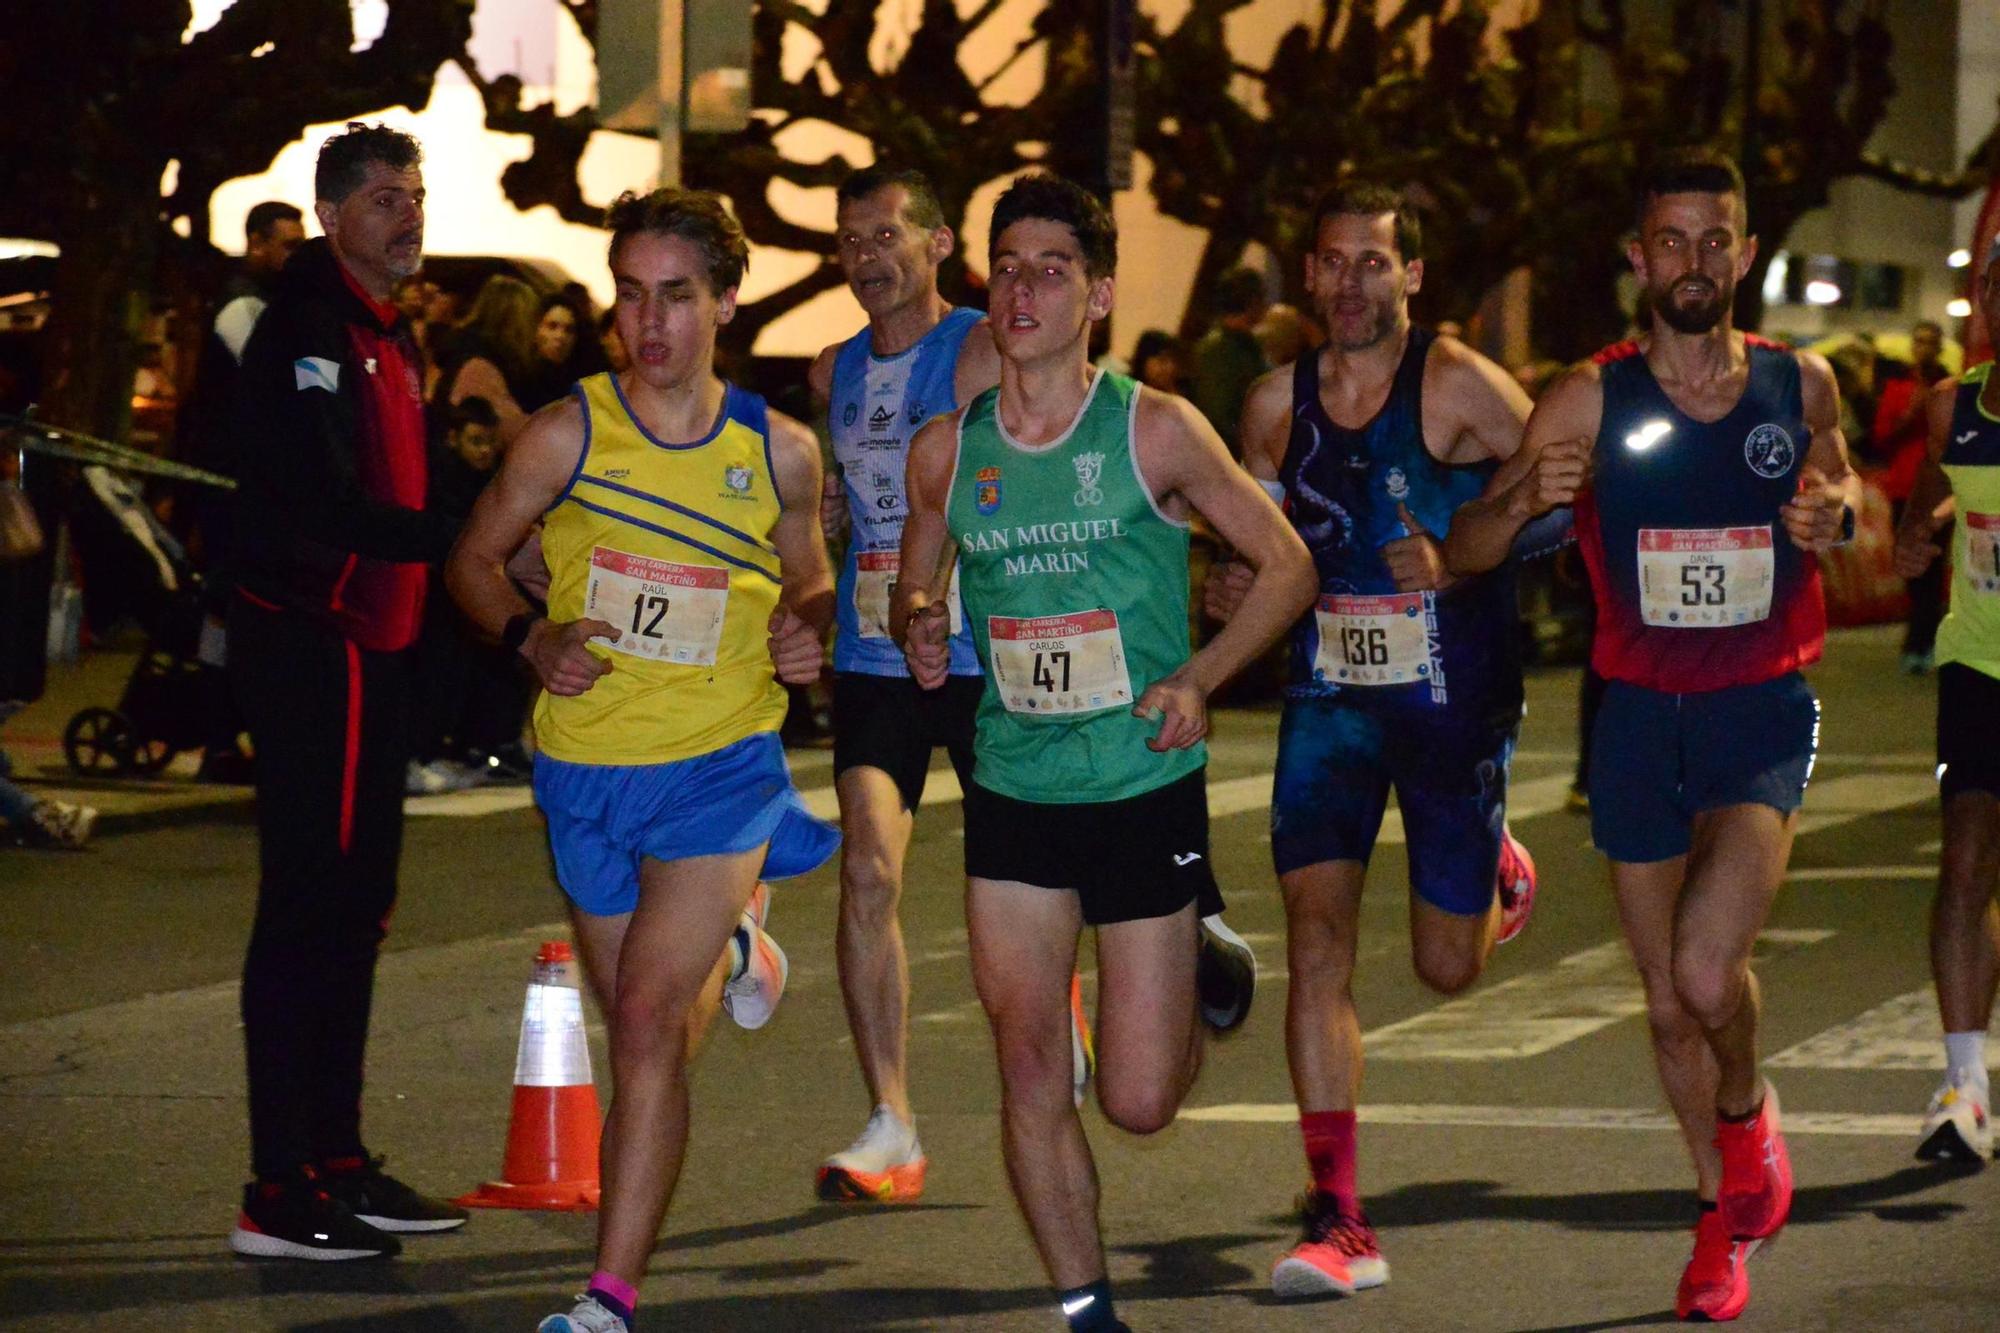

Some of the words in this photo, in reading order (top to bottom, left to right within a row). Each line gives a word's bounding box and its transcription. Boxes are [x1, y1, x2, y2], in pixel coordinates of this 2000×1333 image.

[963, 528, 1008, 552] SAN
[1016, 518, 1127, 547] MIGUEL
[1004, 548, 1088, 576] MARÍN
[1690, 554, 1715, 563] DANI
[625, 566, 648, 580] SAN
[650, 571, 697, 587] MARTIÑO
[641, 582, 667, 596] RAÚL
[1681, 565, 1725, 606] 53
[631, 593, 670, 639] 12
[1015, 629, 1036, 640] SAN
[1038, 623, 1082, 638] MARTIÑO
[1029, 641, 1065, 651] CARLOS
[1340, 627, 1389, 665] 136
[1033, 651, 1070, 692] 47
